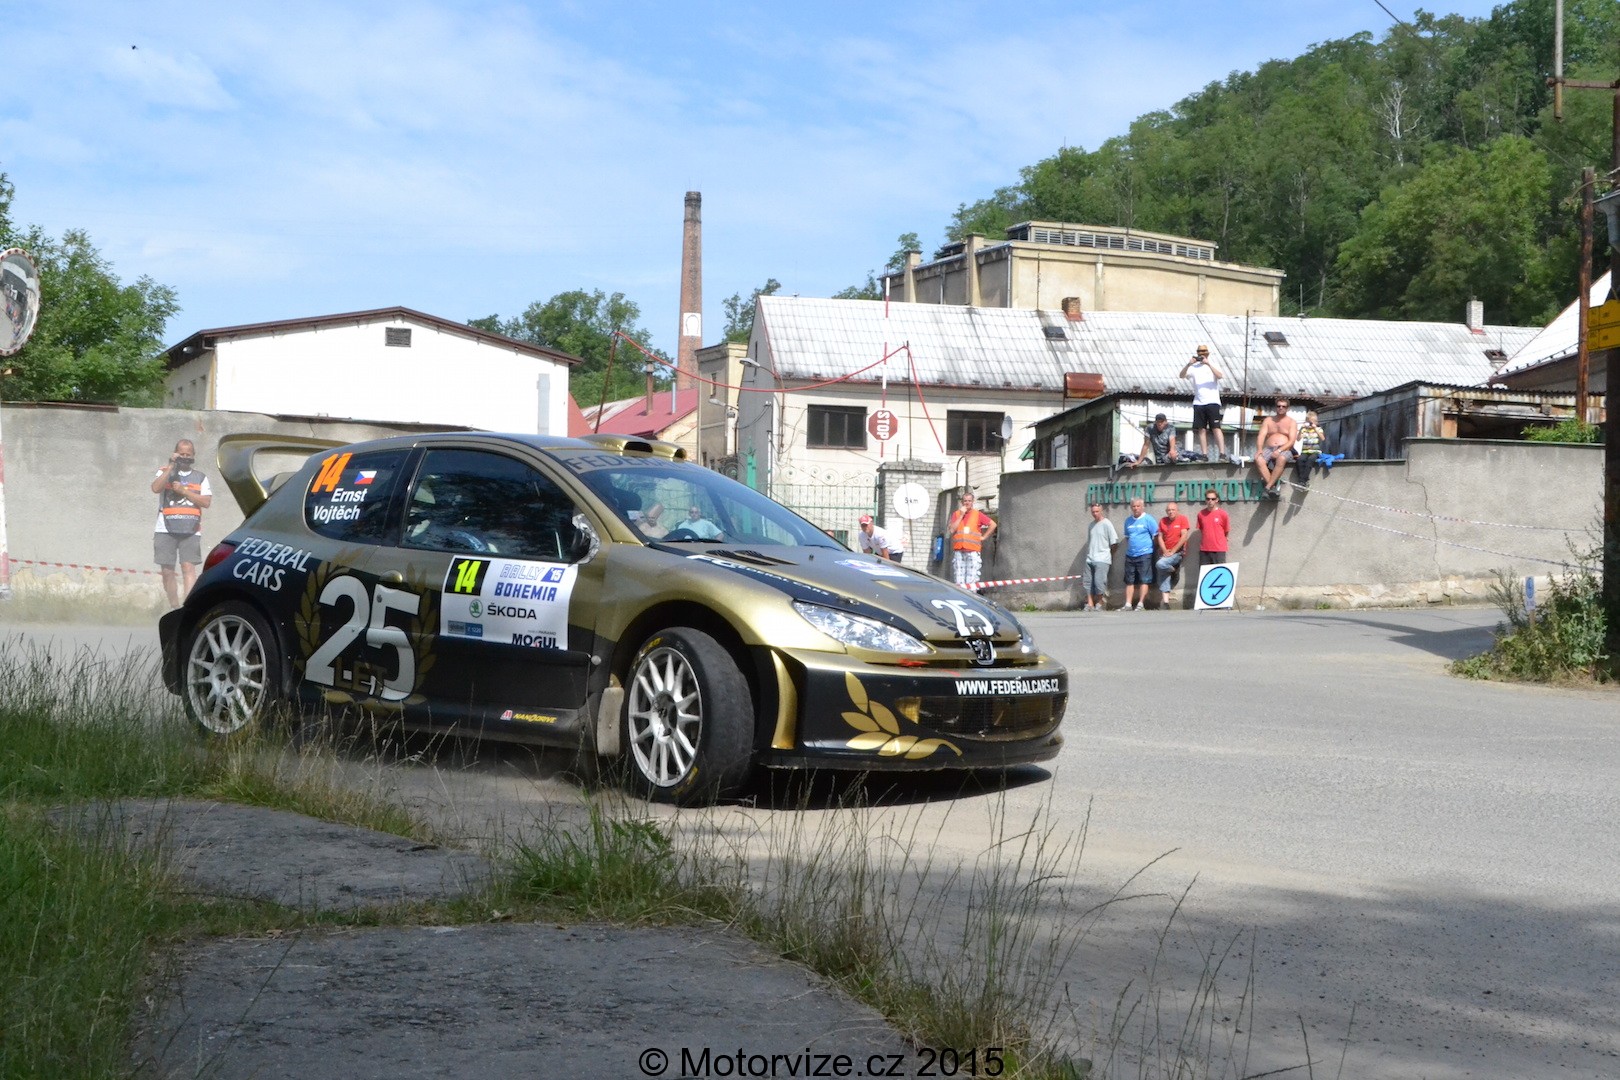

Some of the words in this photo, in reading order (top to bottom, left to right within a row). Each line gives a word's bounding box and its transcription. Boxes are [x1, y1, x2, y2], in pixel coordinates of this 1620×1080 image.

[876, 410, 890, 440] STOP
[311, 452, 353, 493] 14
[331, 488, 368, 503] Ernst
[313, 505, 361, 524] Vojtěch
[234, 536, 312, 573] FEDERAL
[232, 558, 286, 592] CARS
[453, 559, 482, 593] 14
[499, 563, 545, 580] RALLY
[494, 582, 558, 602] BOHEMIA
[487, 602, 537, 620] ŠKODA
[931, 599, 994, 637] 25
[305, 575, 421, 701] 25
[511, 632, 560, 649] MOGUL
[955, 678, 1060, 696] WWW.FEDERALCARS.CZ
